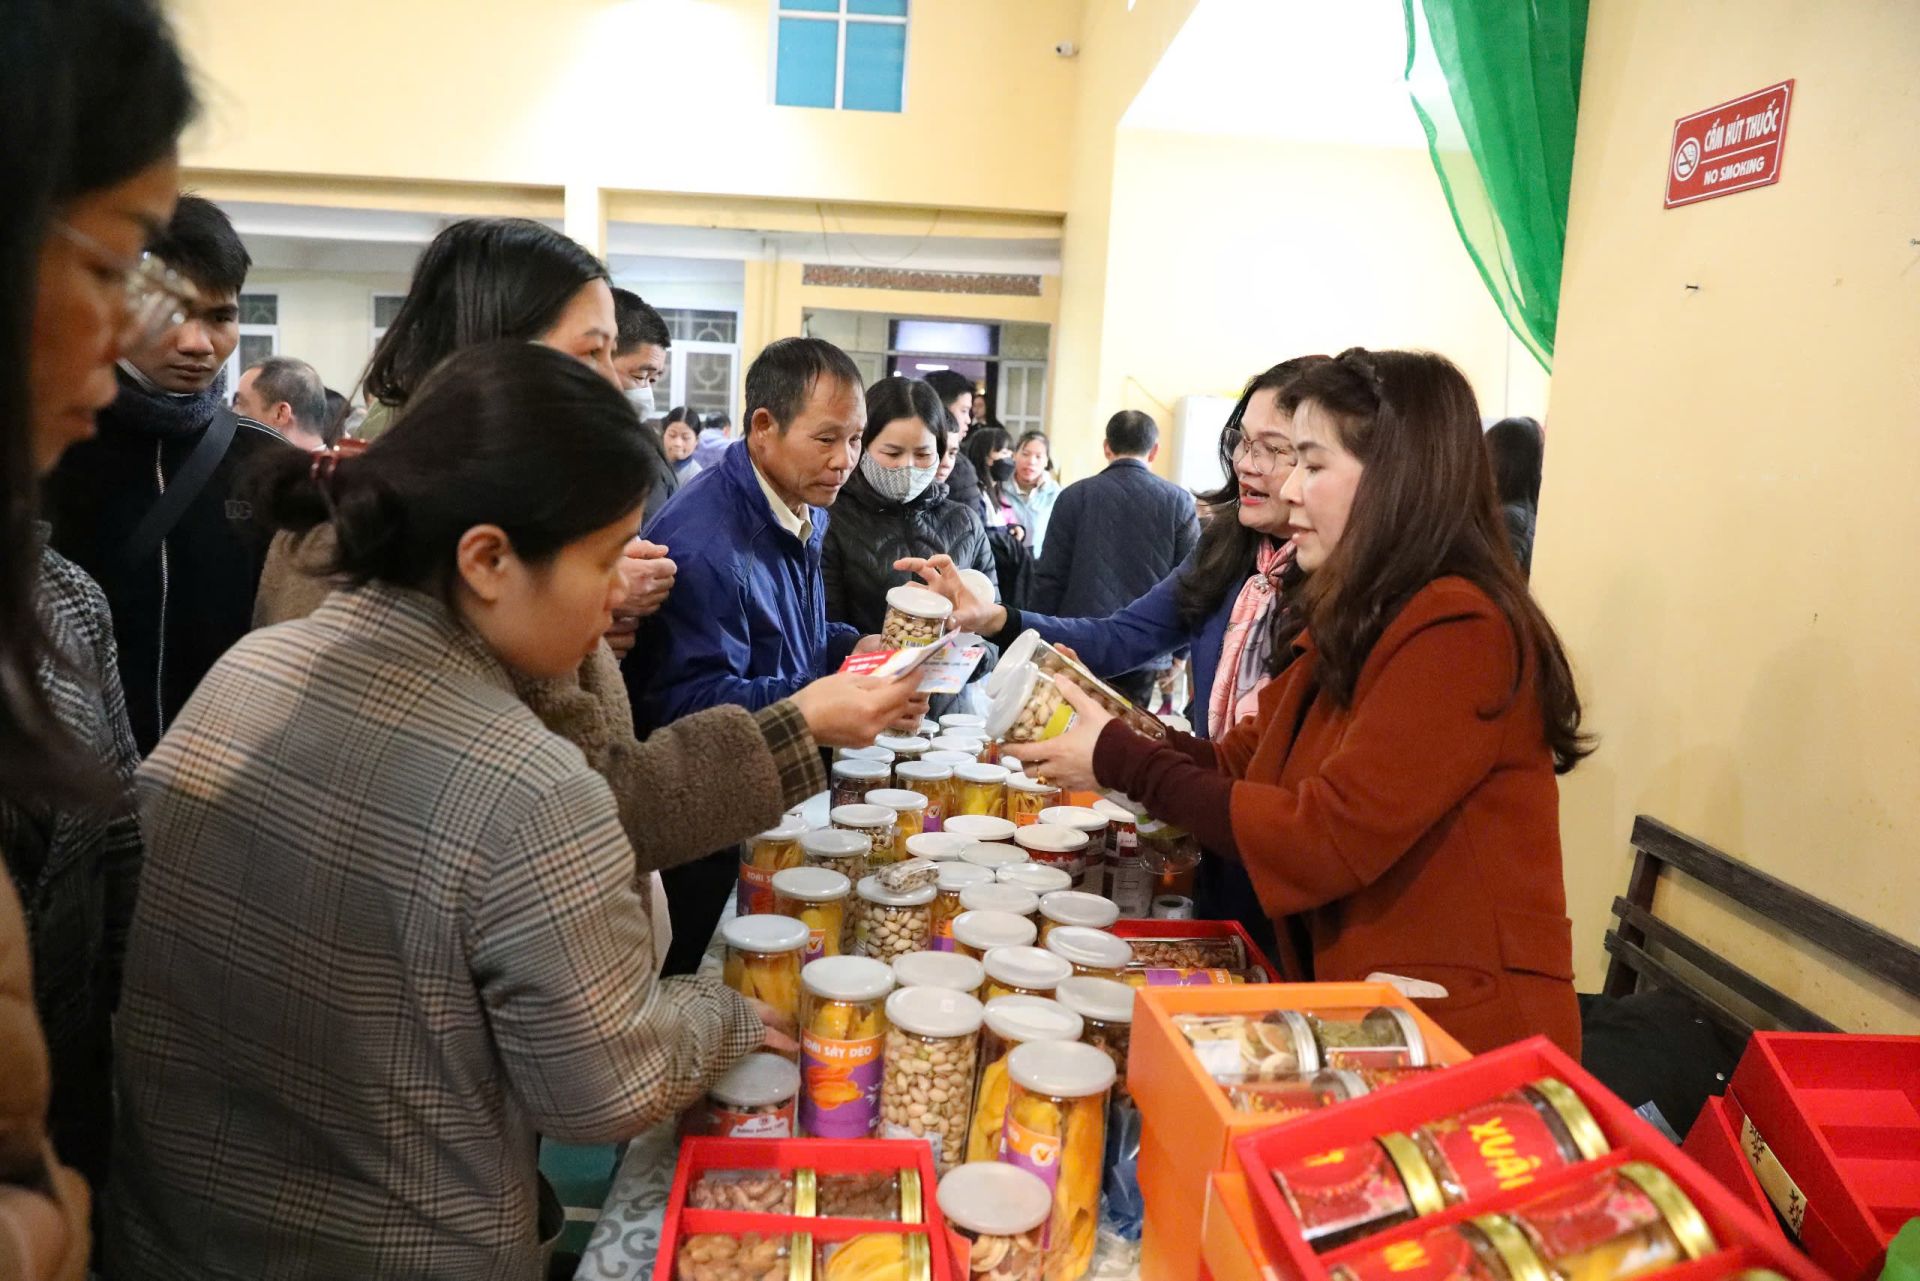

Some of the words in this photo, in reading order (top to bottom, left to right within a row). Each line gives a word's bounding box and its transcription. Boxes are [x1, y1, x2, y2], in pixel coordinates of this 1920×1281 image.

[1704, 118, 1725, 153] CẤM
[1725, 114, 1744, 147] HÚT
[1744, 98, 1780, 141] THUỐC
[1704, 169, 1718, 185] NO
[1719, 156, 1765, 181] SMOKING
